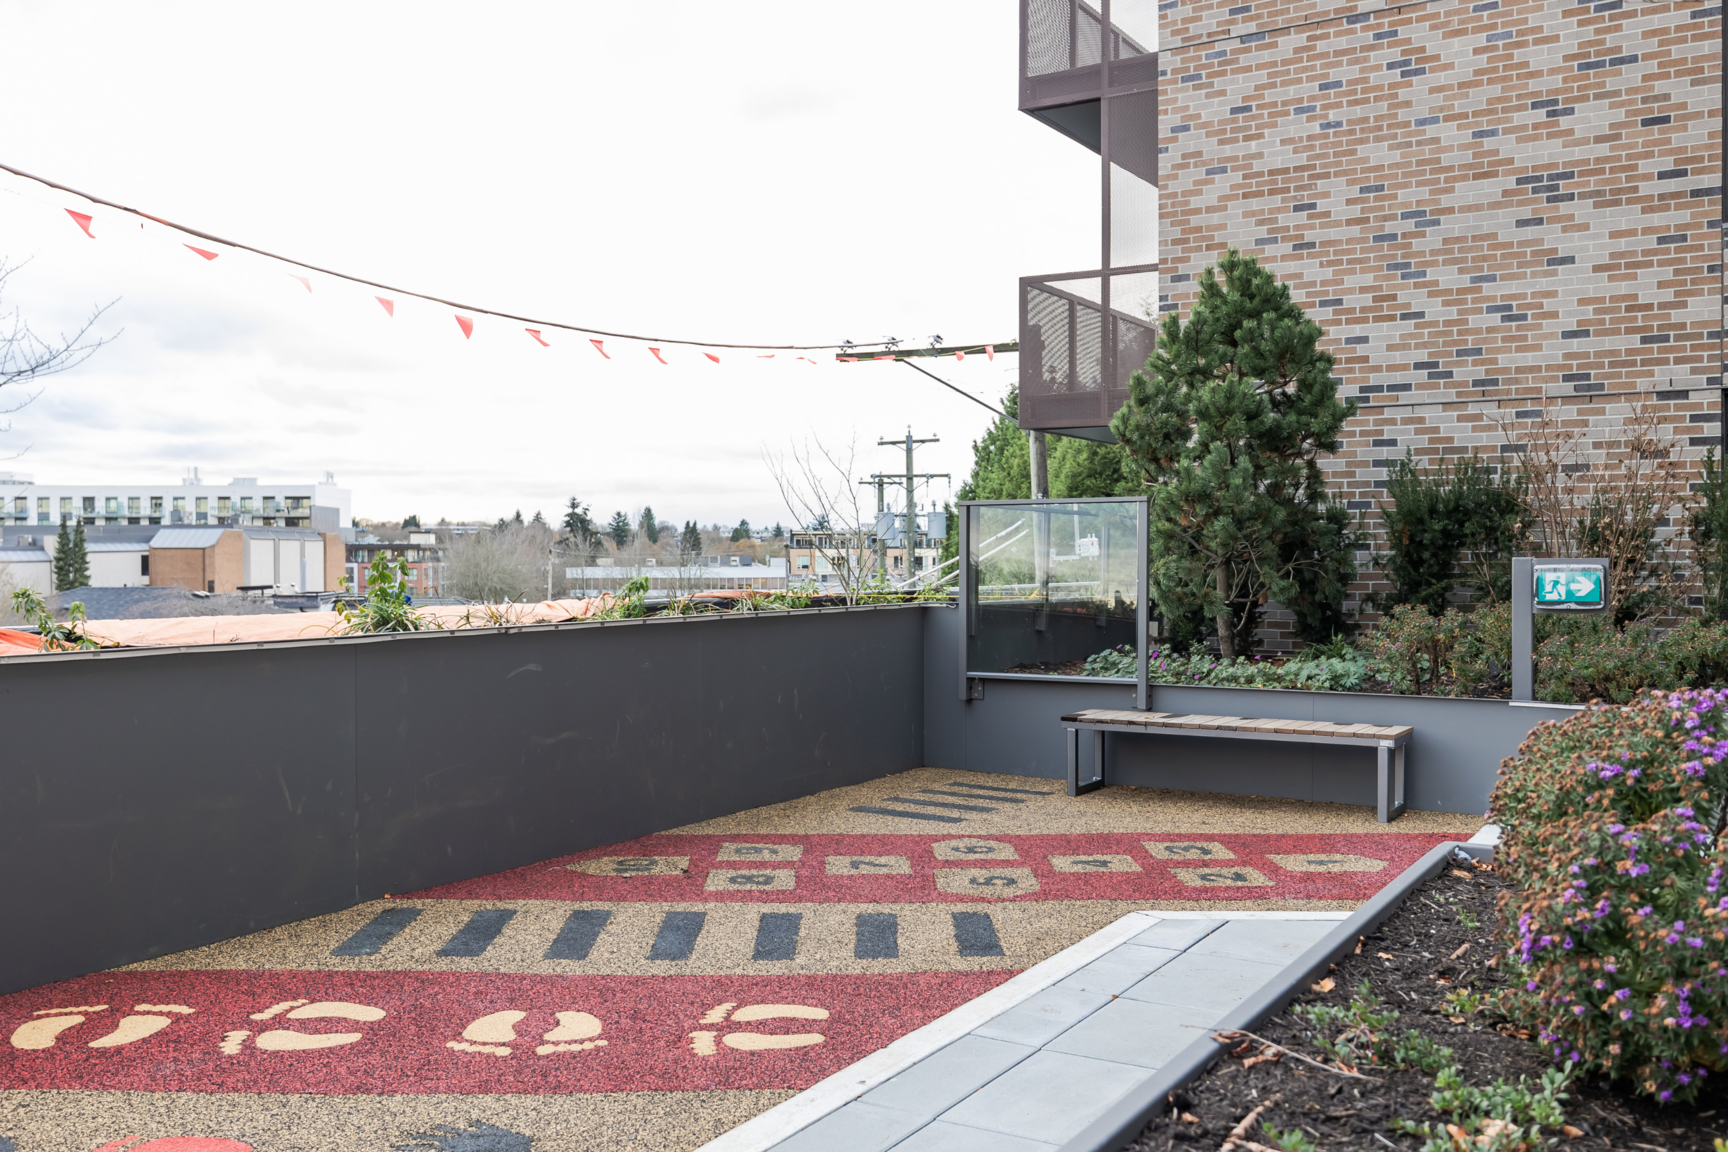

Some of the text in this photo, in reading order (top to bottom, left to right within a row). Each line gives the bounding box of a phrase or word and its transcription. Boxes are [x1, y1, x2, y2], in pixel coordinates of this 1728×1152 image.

[734, 846, 779, 855] 9
[951, 845, 996, 854] 6
[1164, 845, 1212, 855] 3
[611, 857, 659, 874] 10
[849, 860, 889, 870] 7
[1070, 859, 1113, 868] 4
[727, 874, 775, 886] 8
[969, 876, 1018, 886] 5
[1196, 871, 1248, 882] 2
